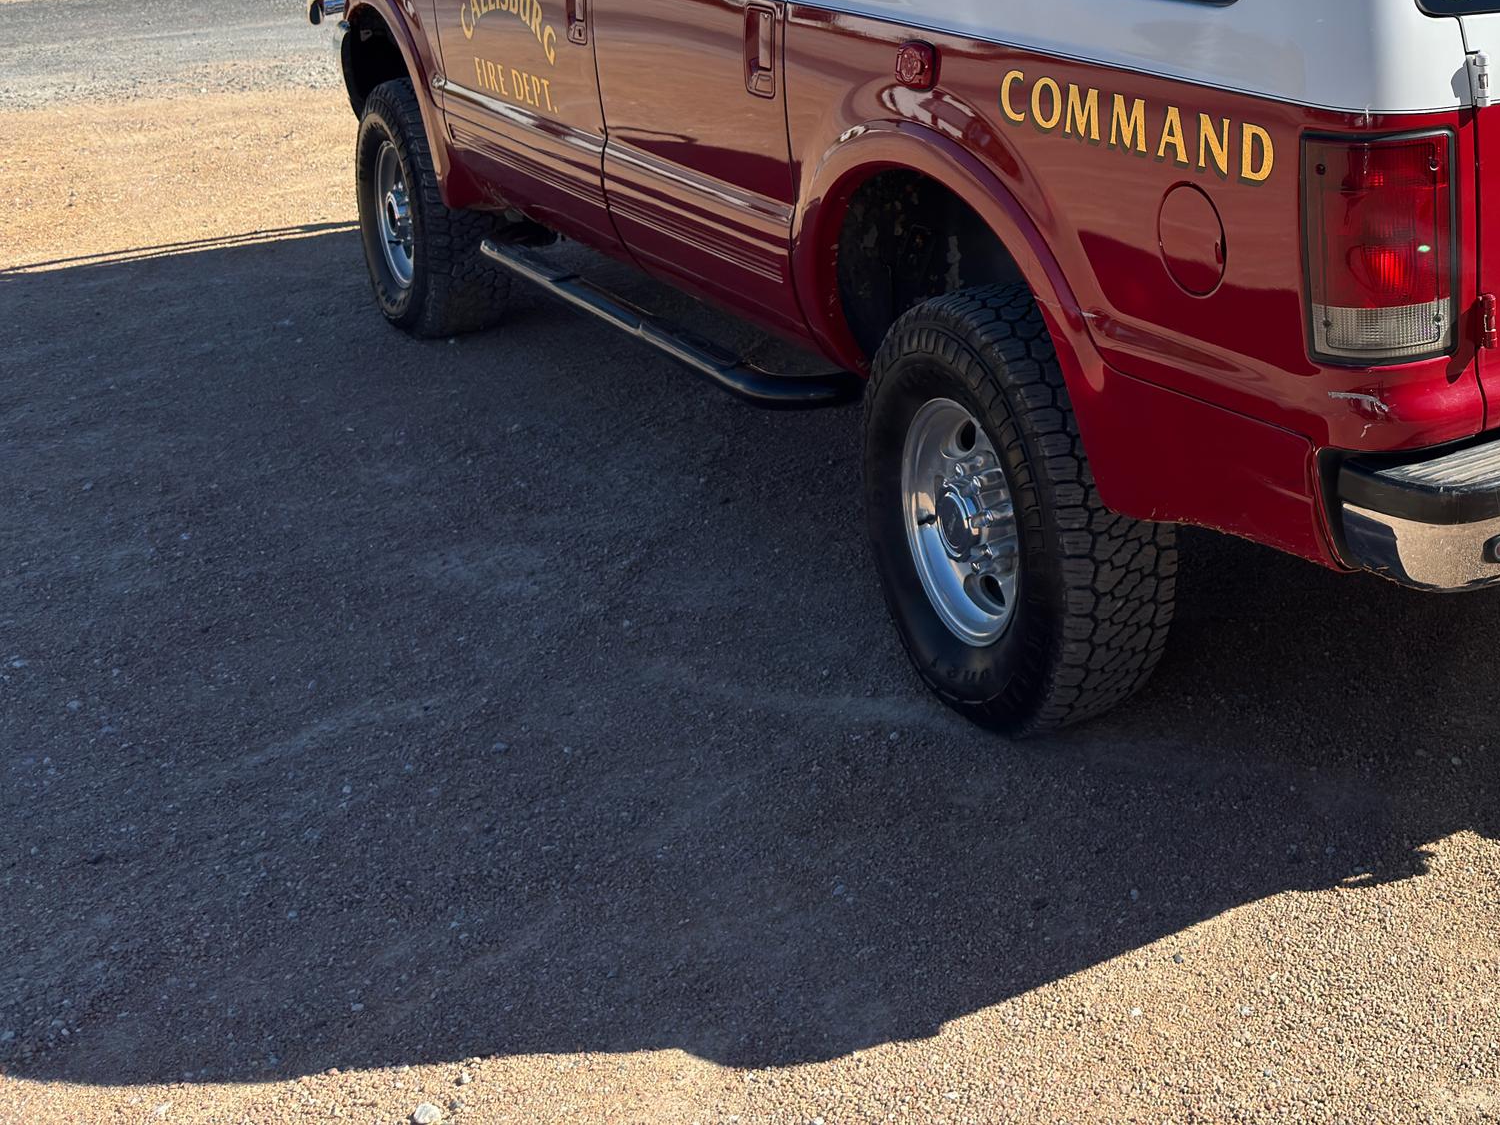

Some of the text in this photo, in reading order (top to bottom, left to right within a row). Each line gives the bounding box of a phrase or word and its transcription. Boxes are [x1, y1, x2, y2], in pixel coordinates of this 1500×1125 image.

[474, 56, 559, 114] FIRE DEPT.
[1000, 70, 1275, 184] COMMAND
